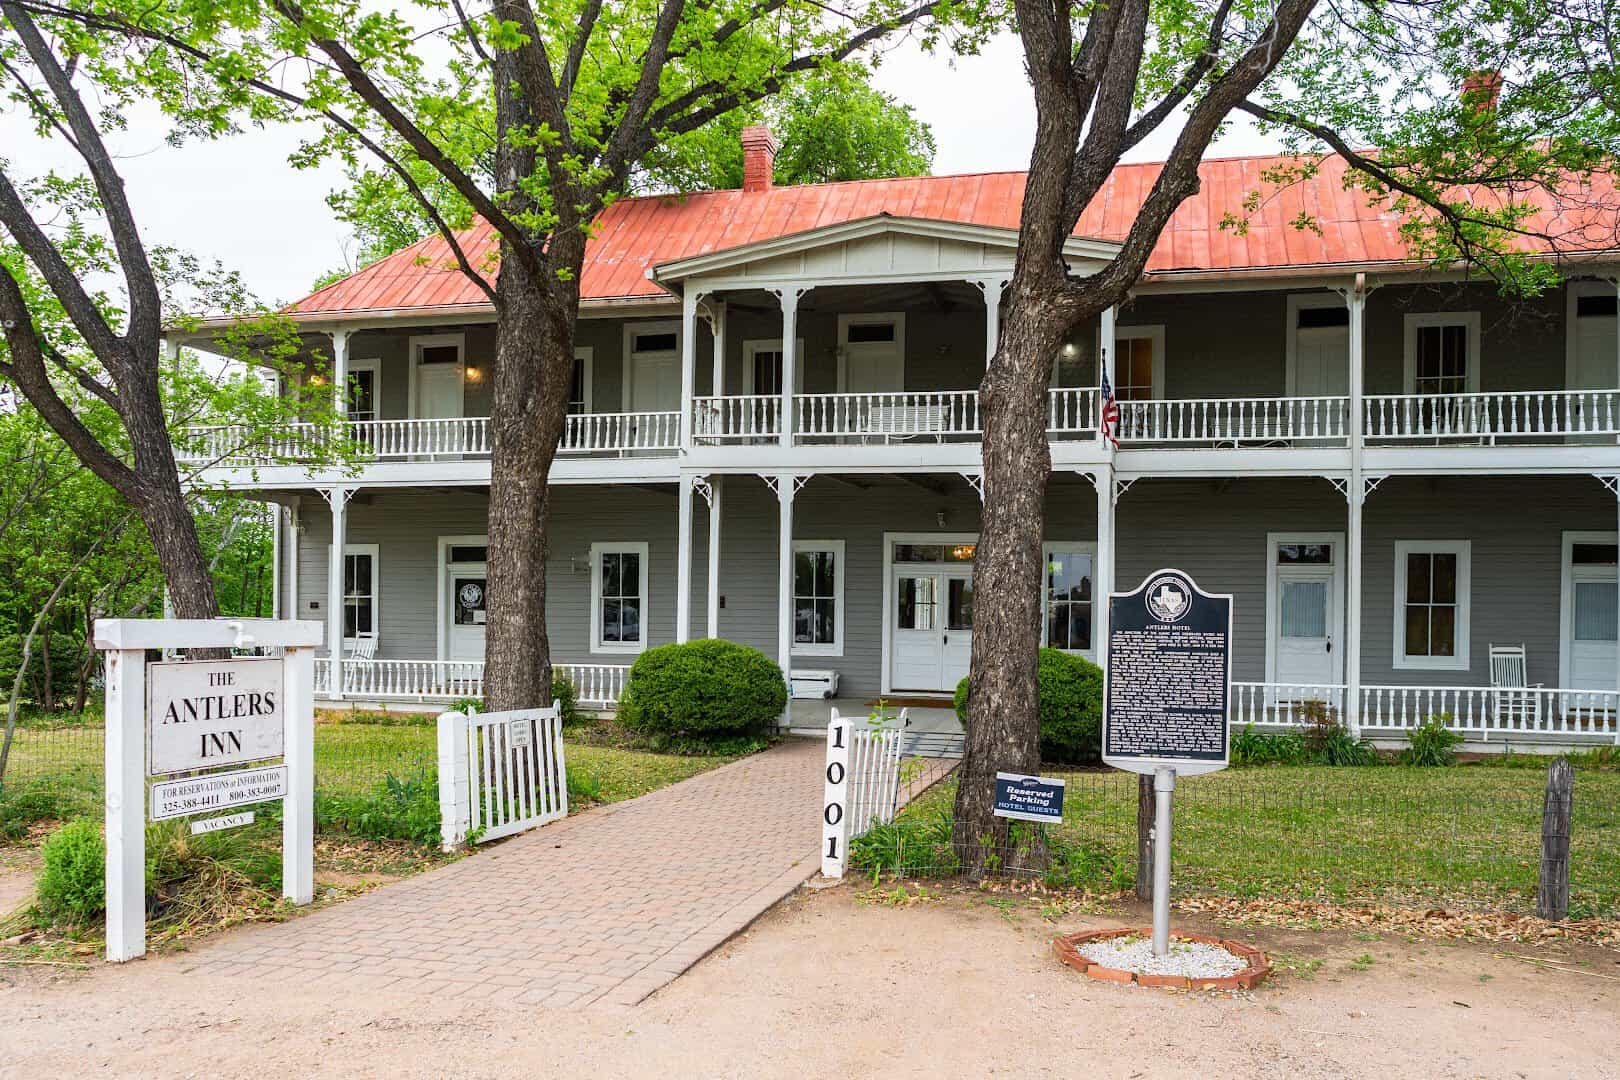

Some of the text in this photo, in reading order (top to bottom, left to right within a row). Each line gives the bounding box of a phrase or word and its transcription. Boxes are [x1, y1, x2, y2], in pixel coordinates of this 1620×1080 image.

[207, 671, 236, 687] THE
[162, 691, 275, 724] ANTLERS
[200, 729, 242, 758] INN
[162, 788, 177, 799] FOR
[179, 781, 229, 795] RESERVATIONS
[236, 772, 280, 787] INFORMATION
[824, 725, 845, 860] 1001
[1006, 786, 1054, 798] Reserved
[162, 794, 219, 813] 325-388-4411
[998, 802, 1058, 814] HOTEL GUESTS
[1009, 793, 1050, 807] Parking
[204, 815, 245, 831] VACANCY
